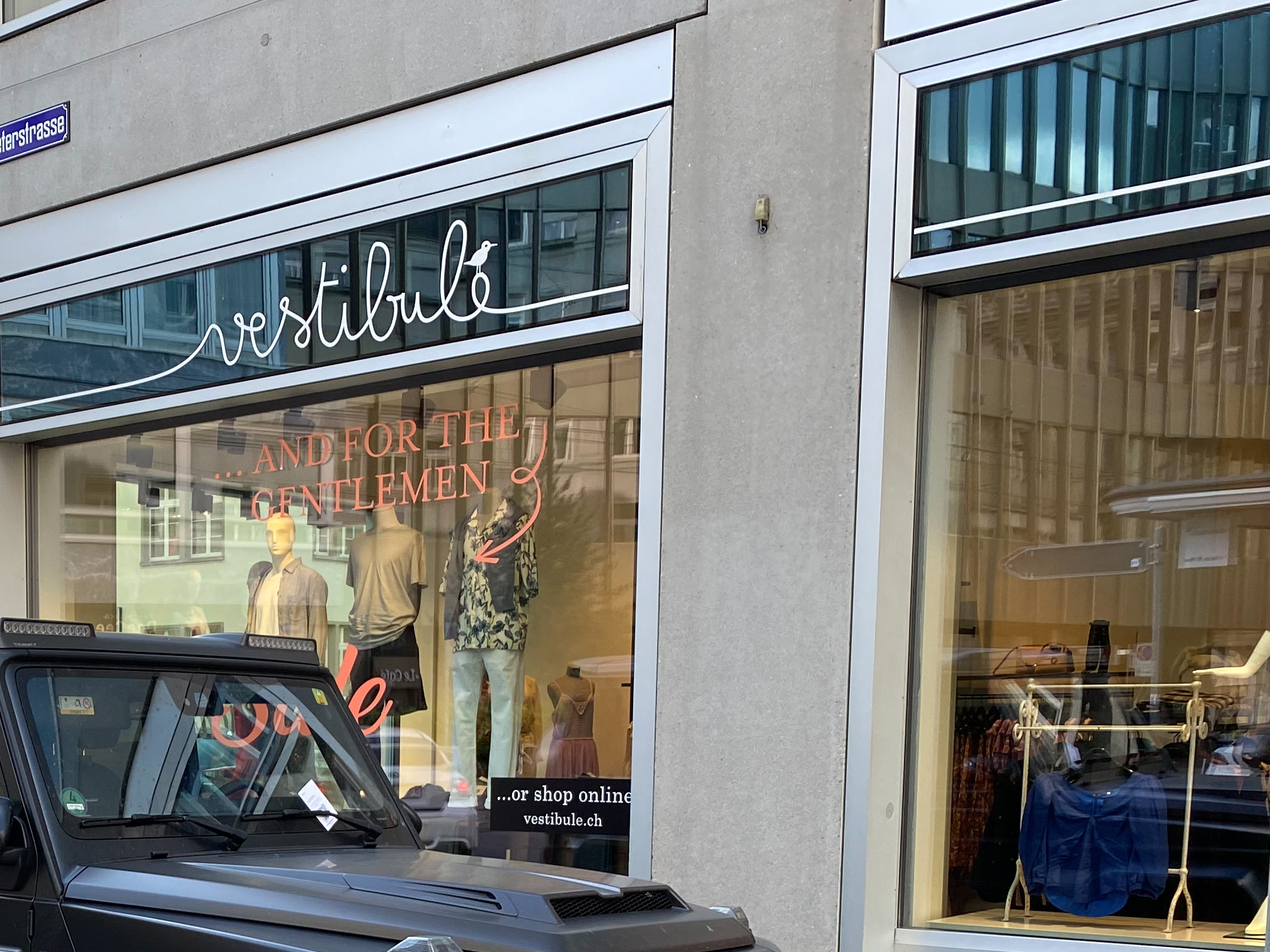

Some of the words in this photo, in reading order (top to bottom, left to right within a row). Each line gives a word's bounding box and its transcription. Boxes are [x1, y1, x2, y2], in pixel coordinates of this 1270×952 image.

[204, 219, 496, 367] vestibule
[252, 433, 330, 475] AND
[341, 418, 421, 462] FOR
[432, 402, 520, 448] THE
[251, 460, 490, 522] GENTLEMEN
[523, 812, 603, 828] vestibule.ch
[534, 785, 572, 806] shop
[579, 785, 632, 804] online
